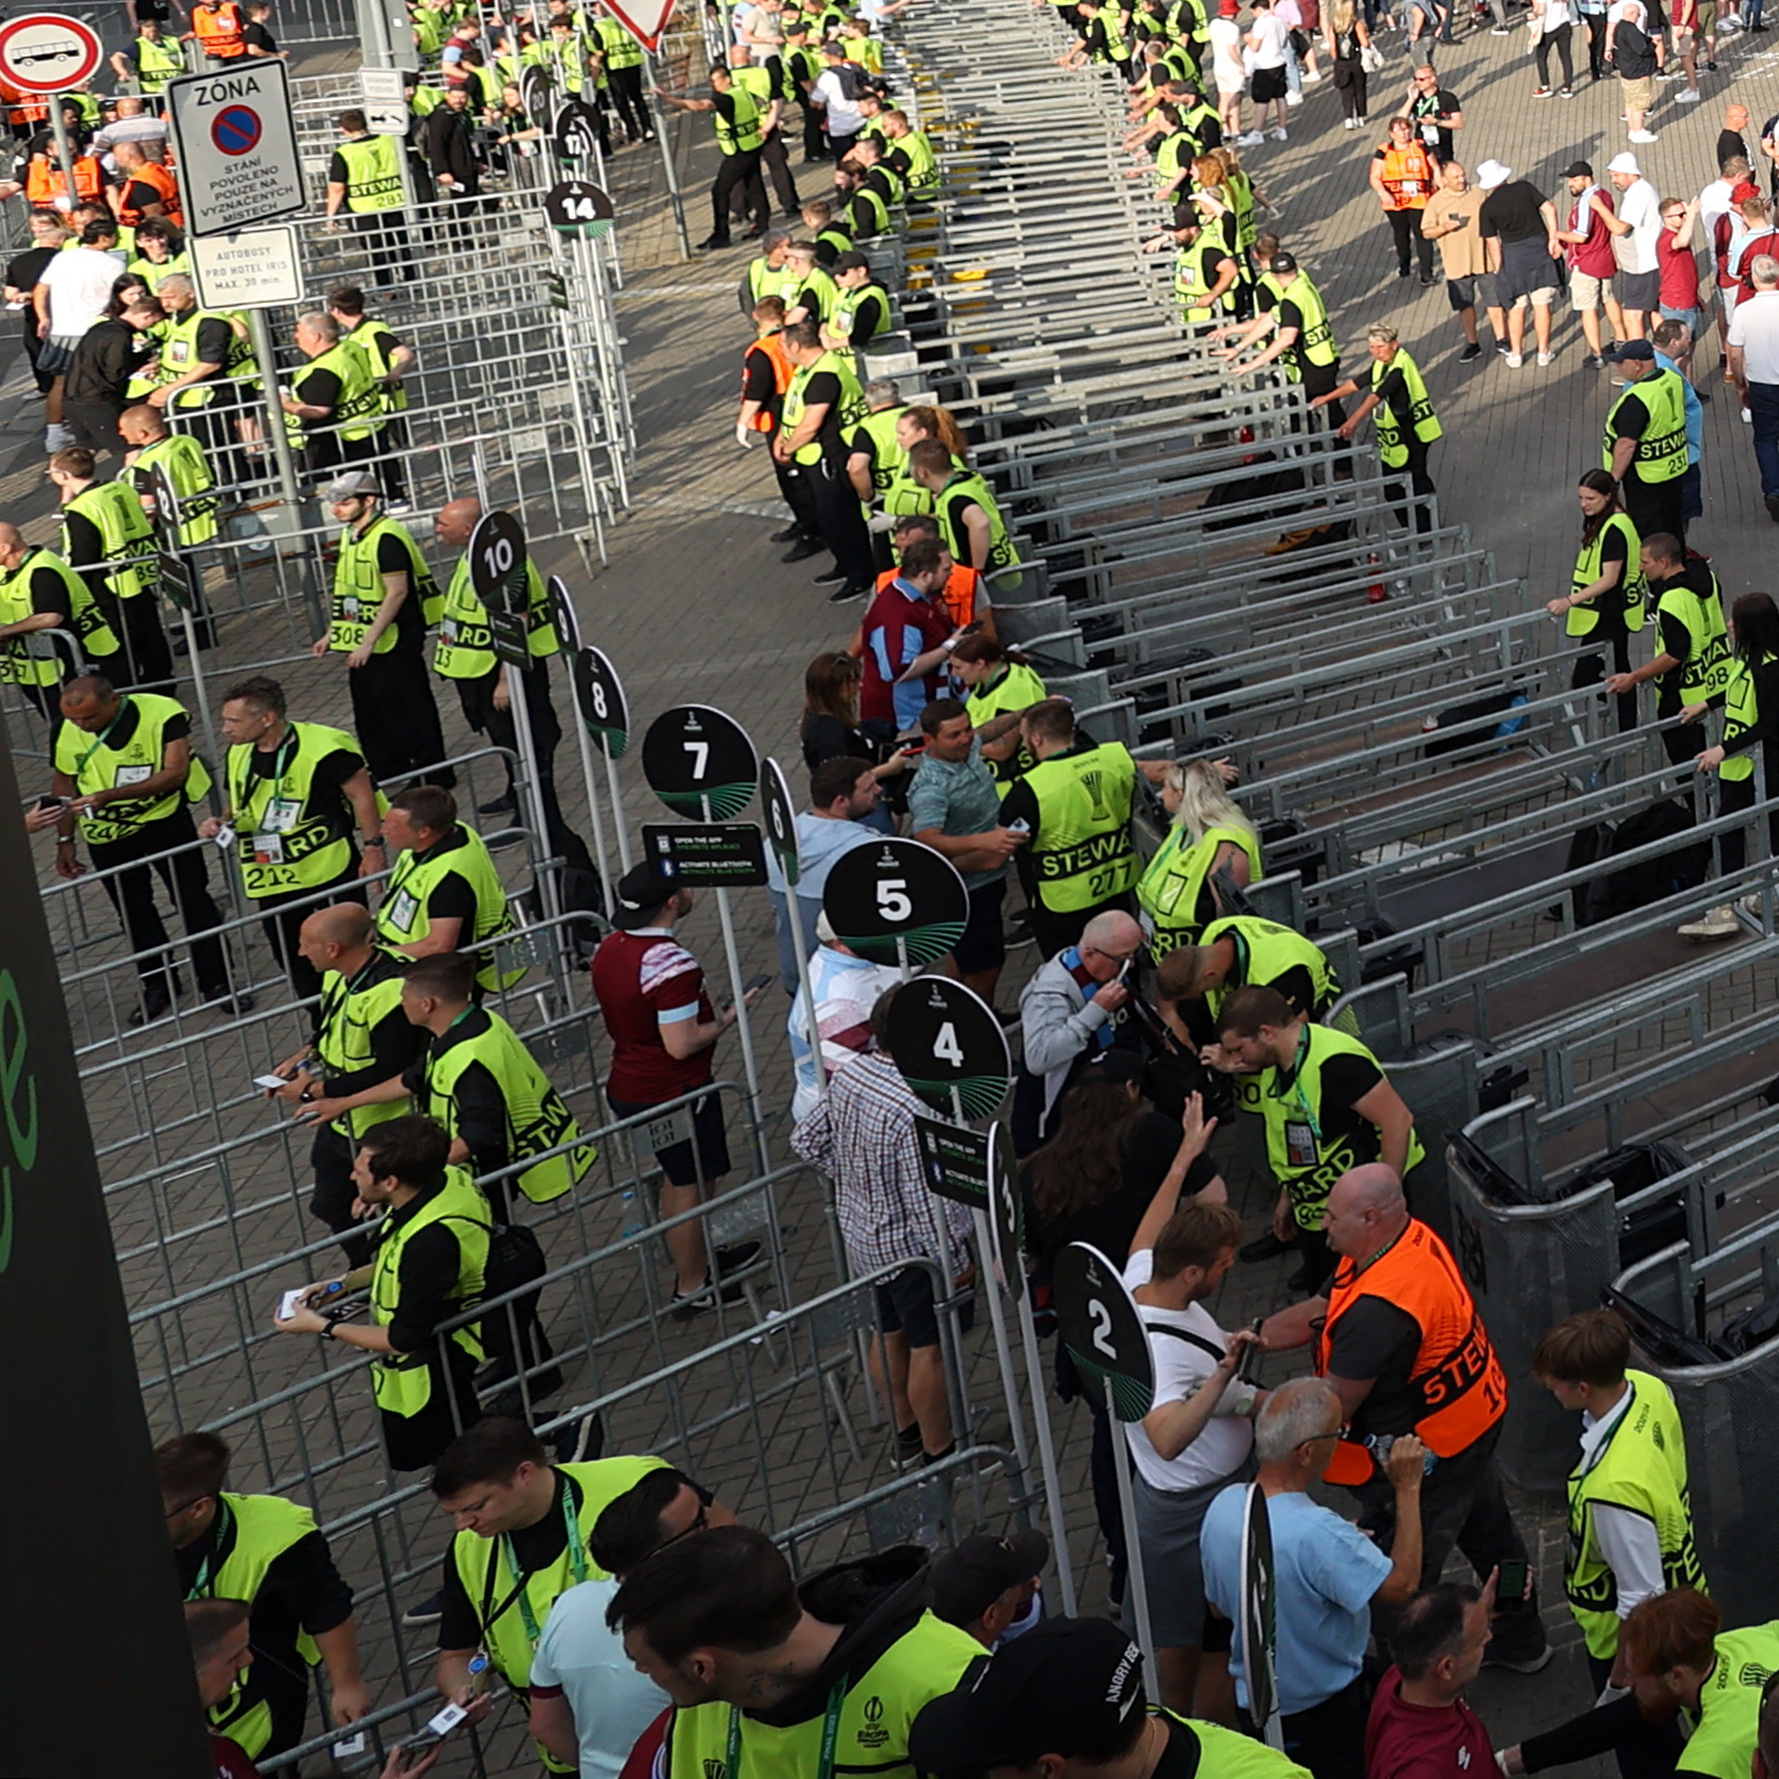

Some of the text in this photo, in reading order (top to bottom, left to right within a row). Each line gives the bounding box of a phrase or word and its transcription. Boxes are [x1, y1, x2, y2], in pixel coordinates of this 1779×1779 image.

[194, 76, 261, 106] ZÓNA
[209, 165, 279, 190] POVOLENO
[224, 155, 263, 175] STÁNÍ
[200, 185, 294, 217] VYZNAČENÝCH
[214, 178, 278, 201] POUZE NA
[222, 201, 278, 224] MÍSTECH
[561, 197, 596, 219] 14
[217, 247, 271, 261] AUTOBUSY
[205, 261, 288, 278] PRO HOTEL IRIS
[484, 538, 512, 579] 10
[591, 681, 607, 719] 8
[683, 741, 709, 780] 7
[247, 867, 301, 891] 212
[1089, 860, 1136, 900] 277
[876, 879, 913, 921] 5
[932, 1021, 965, 1068] 4
[1087, 1297, 1119, 1360] 2
